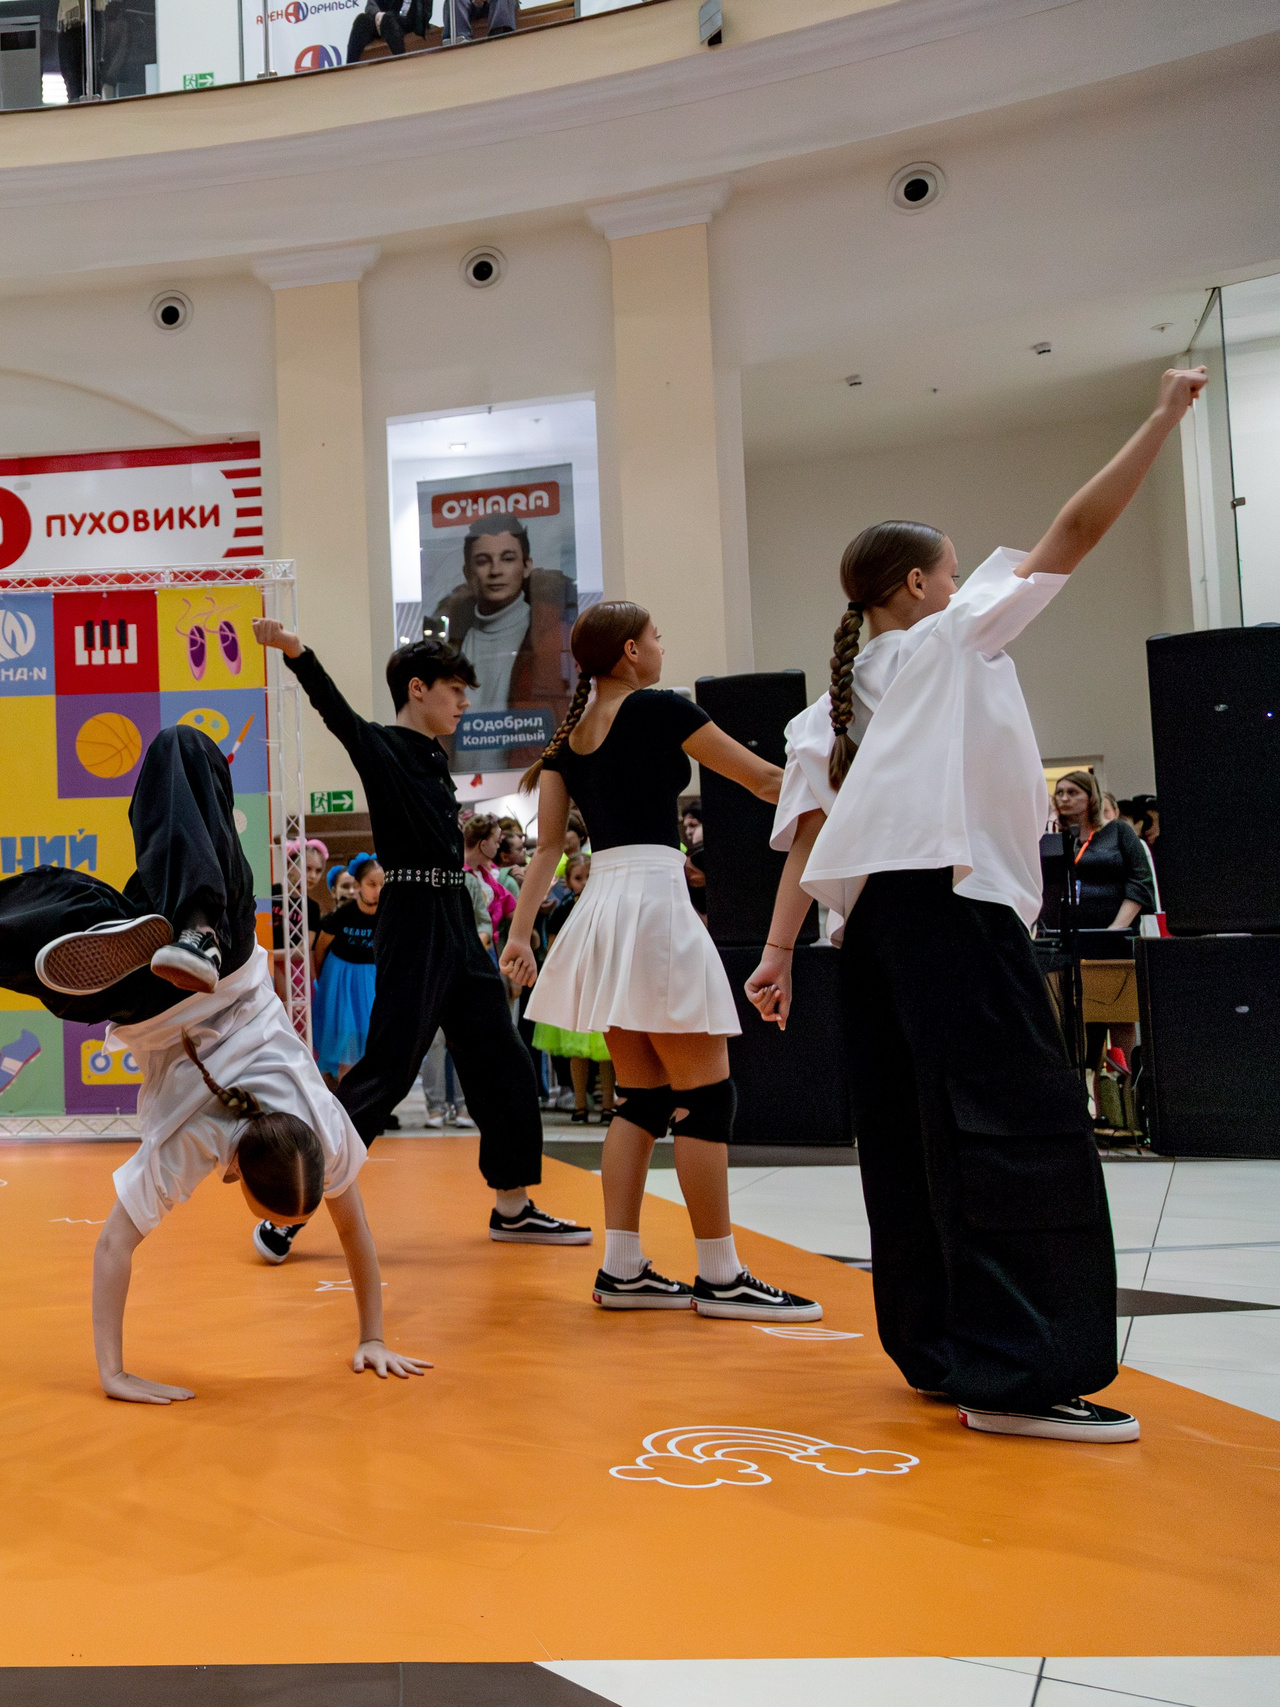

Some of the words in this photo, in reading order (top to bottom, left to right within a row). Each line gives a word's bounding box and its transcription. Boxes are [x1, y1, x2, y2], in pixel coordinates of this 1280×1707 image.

[441, 489, 549, 519] O'HARA
[46, 504, 220, 537] ПУХОВИКИ
[462, 716, 543, 732] #Одобрил
[462, 730, 546, 745] Кологривый
